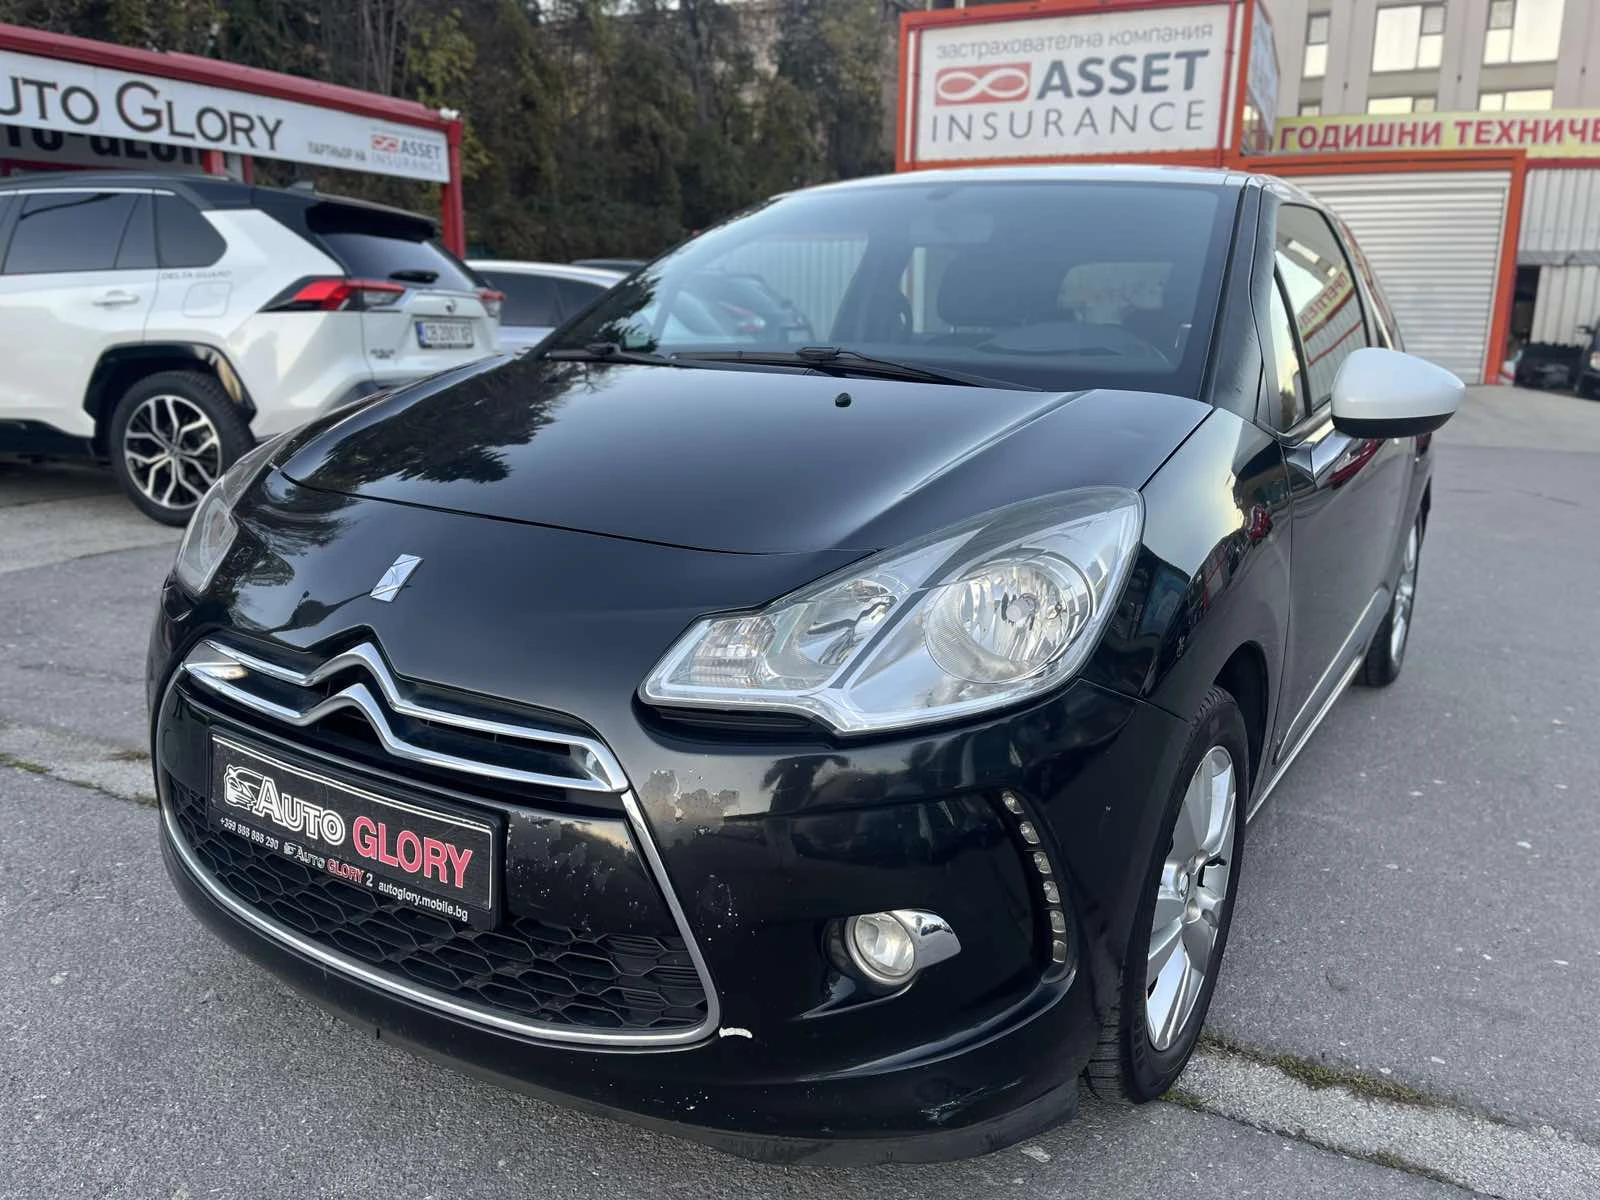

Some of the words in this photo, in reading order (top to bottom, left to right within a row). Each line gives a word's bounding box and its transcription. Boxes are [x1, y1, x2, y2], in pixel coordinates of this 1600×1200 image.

[936, 31, 1103, 61] застрахователна
[1108, 24, 1213, 45] компания
[1036, 50, 1211, 100] ASSET
[116, 80, 283, 151] GLORY
[931, 100, 1206, 143] INSURANCE
[1280, 121, 1444, 150] ГОДИШНИ
[401, 139, 441, 159] ASSET
[252, 776, 345, 846] AUTO
[352, 815, 473, 888] GLORY
[294, 846, 325, 868] AUTO
[327, 858, 365, 884] GLORY
[365, 872, 373, 887] 2
[378, 881, 468, 922] autoglory.mobile.bg
